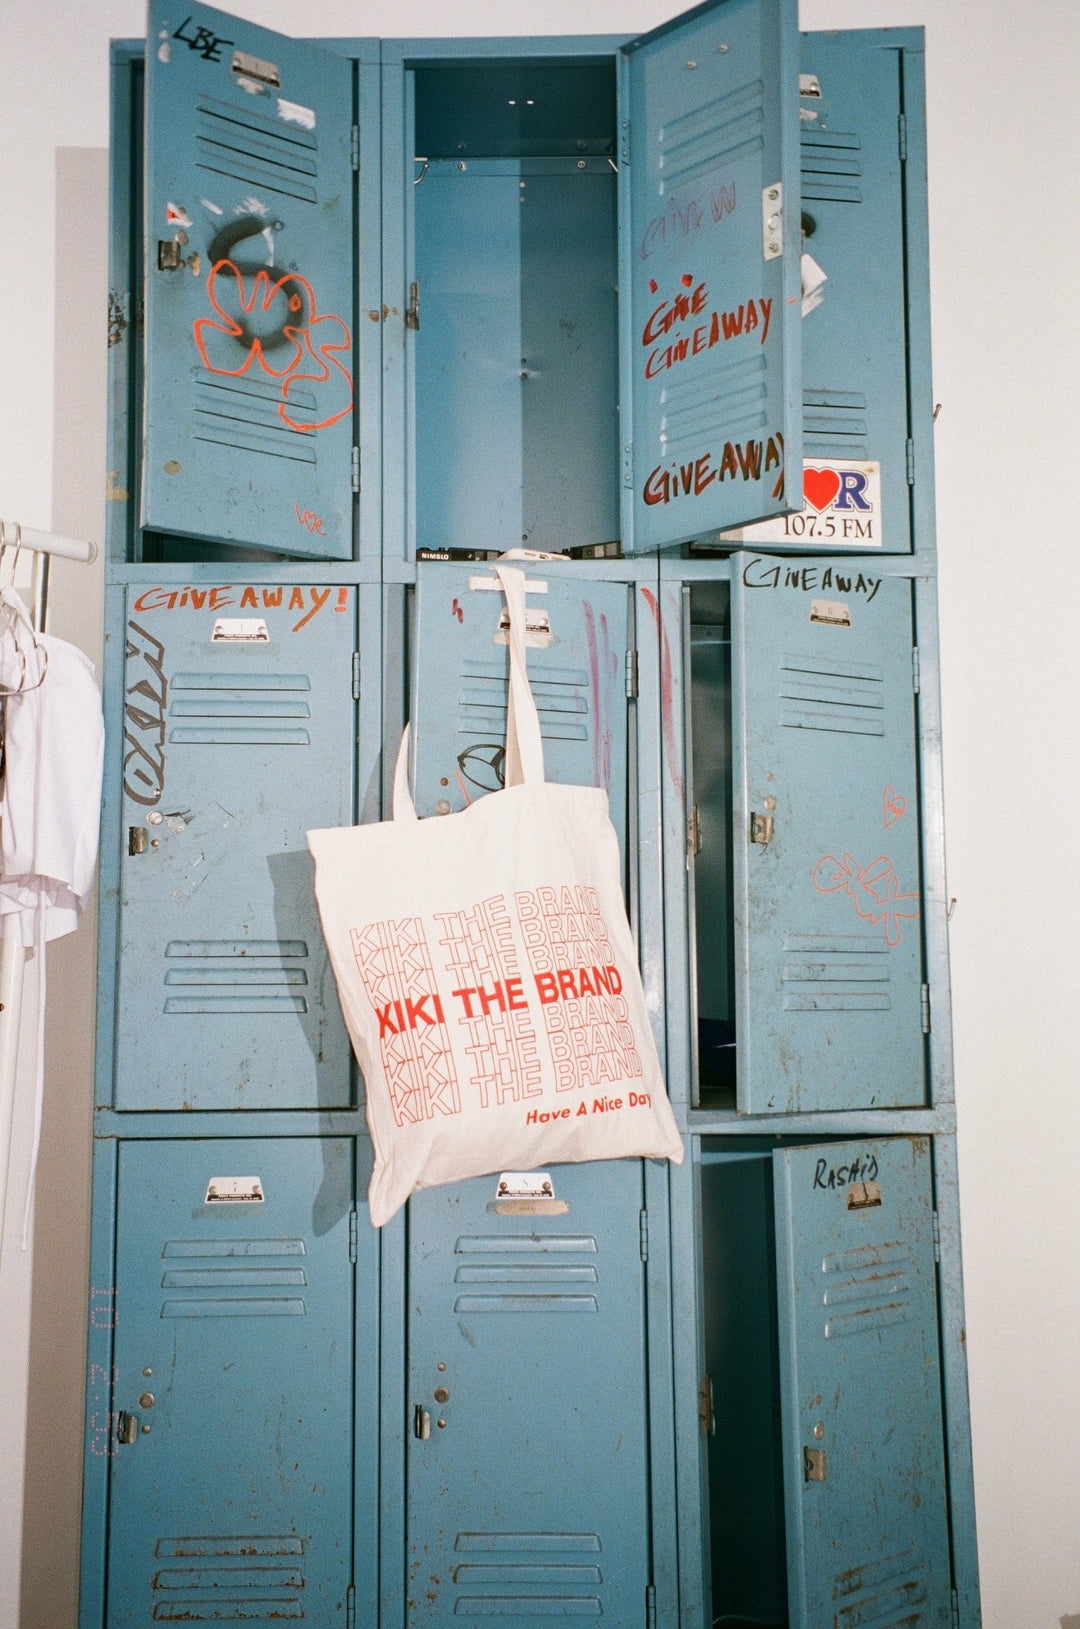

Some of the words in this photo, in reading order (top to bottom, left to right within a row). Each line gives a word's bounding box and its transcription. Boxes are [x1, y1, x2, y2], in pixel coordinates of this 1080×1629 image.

[783, 515, 836, 537] 107.5
[842, 518, 874, 539] FM
[350, 917, 426, 957] KIKI
[433, 894, 511, 940] THE
[514, 885, 600, 920] BRAND
[355, 943, 433, 984] KIKI
[439, 921, 517, 965] THE
[520, 912, 608, 949] BRAND
[364, 968, 440, 1009] KIKI
[446, 949, 521, 990] THE
[526, 940, 615, 976] BRAND
[375, 994, 445, 1038] KIKI
[452, 977, 528, 1018] THE
[534, 965, 622, 1004] BRAND
[380, 1022, 451, 1068] KIKI
[459, 1007, 535, 1047] THE
[541, 993, 629, 1034] BRAND
[384, 1050, 458, 1097] KIKI
[465, 1035, 541, 1077] THE
[547, 1021, 635, 1063] BRAND
[391, 1080, 462, 1127] KIKI
[471, 1064, 543, 1108] THE
[553, 1048, 642, 1093] BRAND
[526, 1109, 571, 1125] Have
[576, 1101, 587, 1117] A
[593, 1096, 623, 1113] Nice
[629, 1091, 652, 1109] Day
